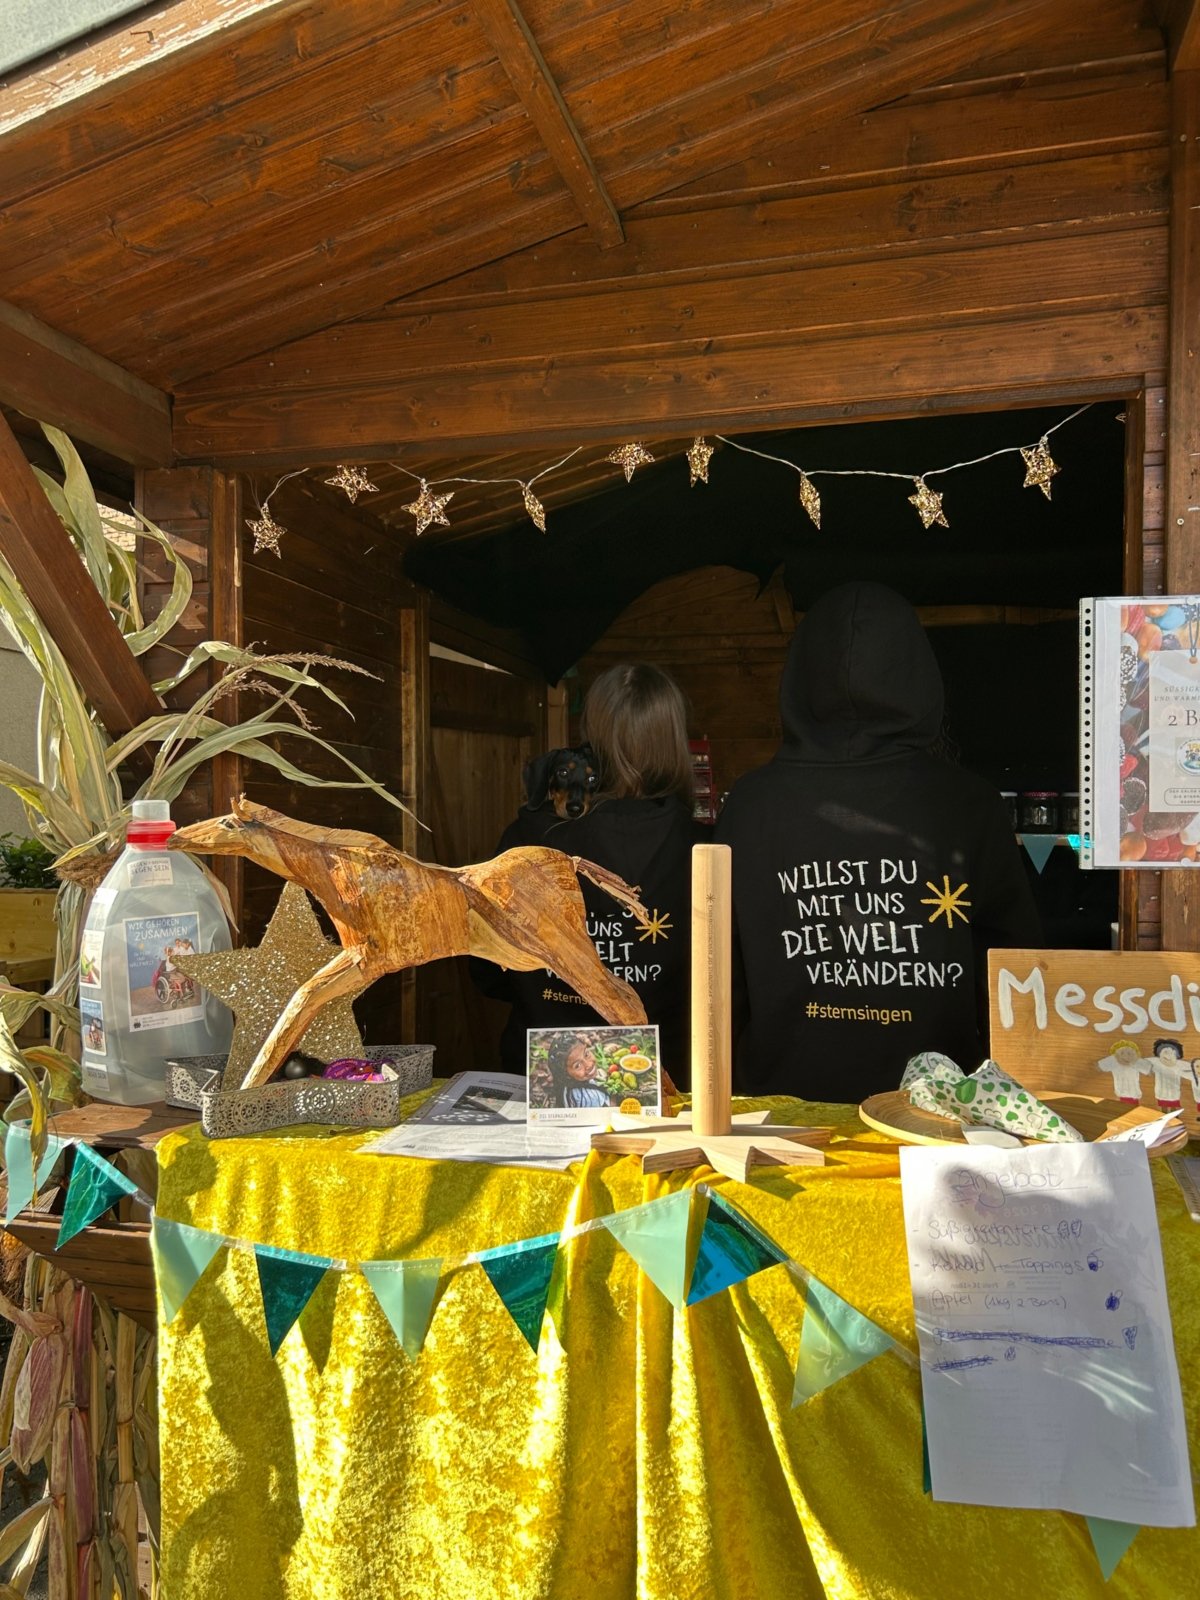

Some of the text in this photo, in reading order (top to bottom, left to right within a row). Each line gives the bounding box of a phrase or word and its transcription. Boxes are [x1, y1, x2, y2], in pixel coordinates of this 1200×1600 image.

[1168, 709, 1200, 726] 2 B
[778, 859, 918, 894] WILLST DU
[797, 892, 905, 919] MIT UNS
[135, 926, 188, 940] ZUSAMMEN
[585, 920, 623, 937] UNS
[781, 920, 924, 959] DIE WELT
[595, 940, 634, 963] ELT
[806, 958, 964, 988] VERÄNDERN?
[805, 1001, 913, 1025] #sternsingen
[952, 1169, 1064, 1208] Angebot
[1013, 1257, 1086, 1275] Toppings
